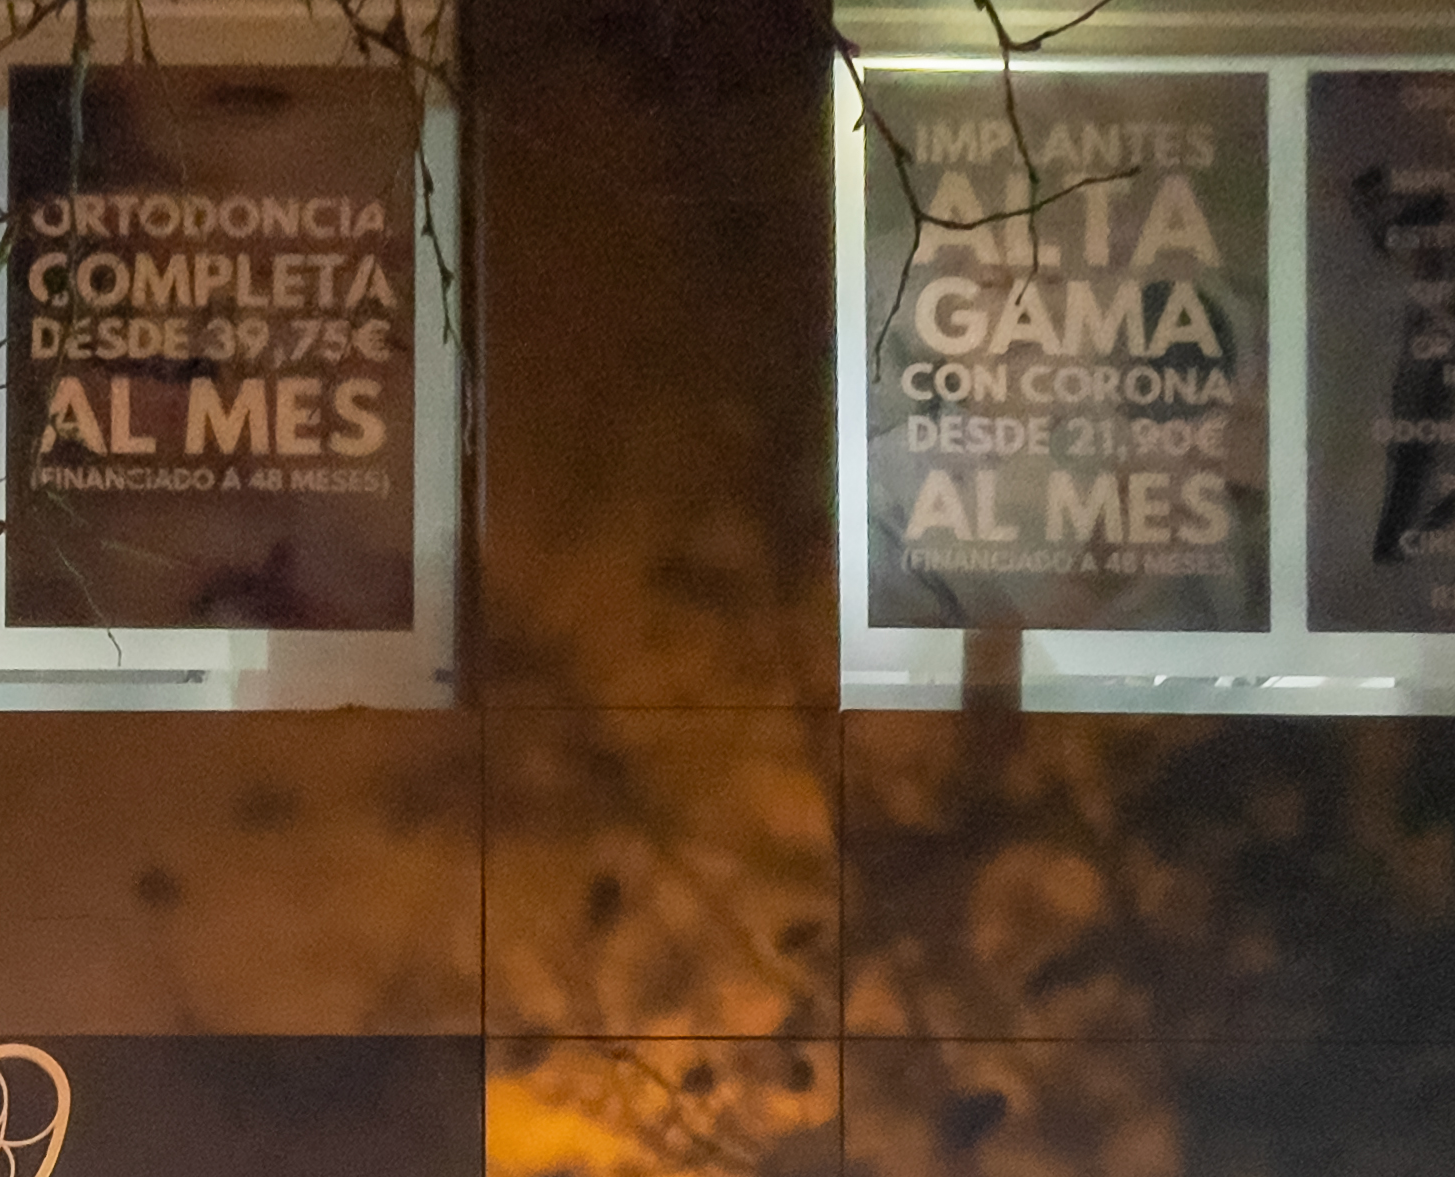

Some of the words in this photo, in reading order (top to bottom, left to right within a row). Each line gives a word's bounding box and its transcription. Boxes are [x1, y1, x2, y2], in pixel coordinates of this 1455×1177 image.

[916, 121, 1215, 166] IMPANTES
[31, 194, 388, 239] ORTODONCIA
[912, 171, 1222, 268] ALTA
[29, 251, 397, 307] COMPLETA
[31, 317, 190, 361] DESDE
[202, 316, 393, 367] 39,75€
[915, 276, 1224, 357] GAMA
[901, 361, 1007, 401] CON
[1021, 365, 1234, 406] CORONA
[39, 375, 158, 456] AL
[184, 375, 388, 458] MES
[908, 415, 1051, 455] DESDE
[220, 466, 241, 490] A
[903, 469, 1020, 541] AL
[1044, 471, 1233, 545] MES
